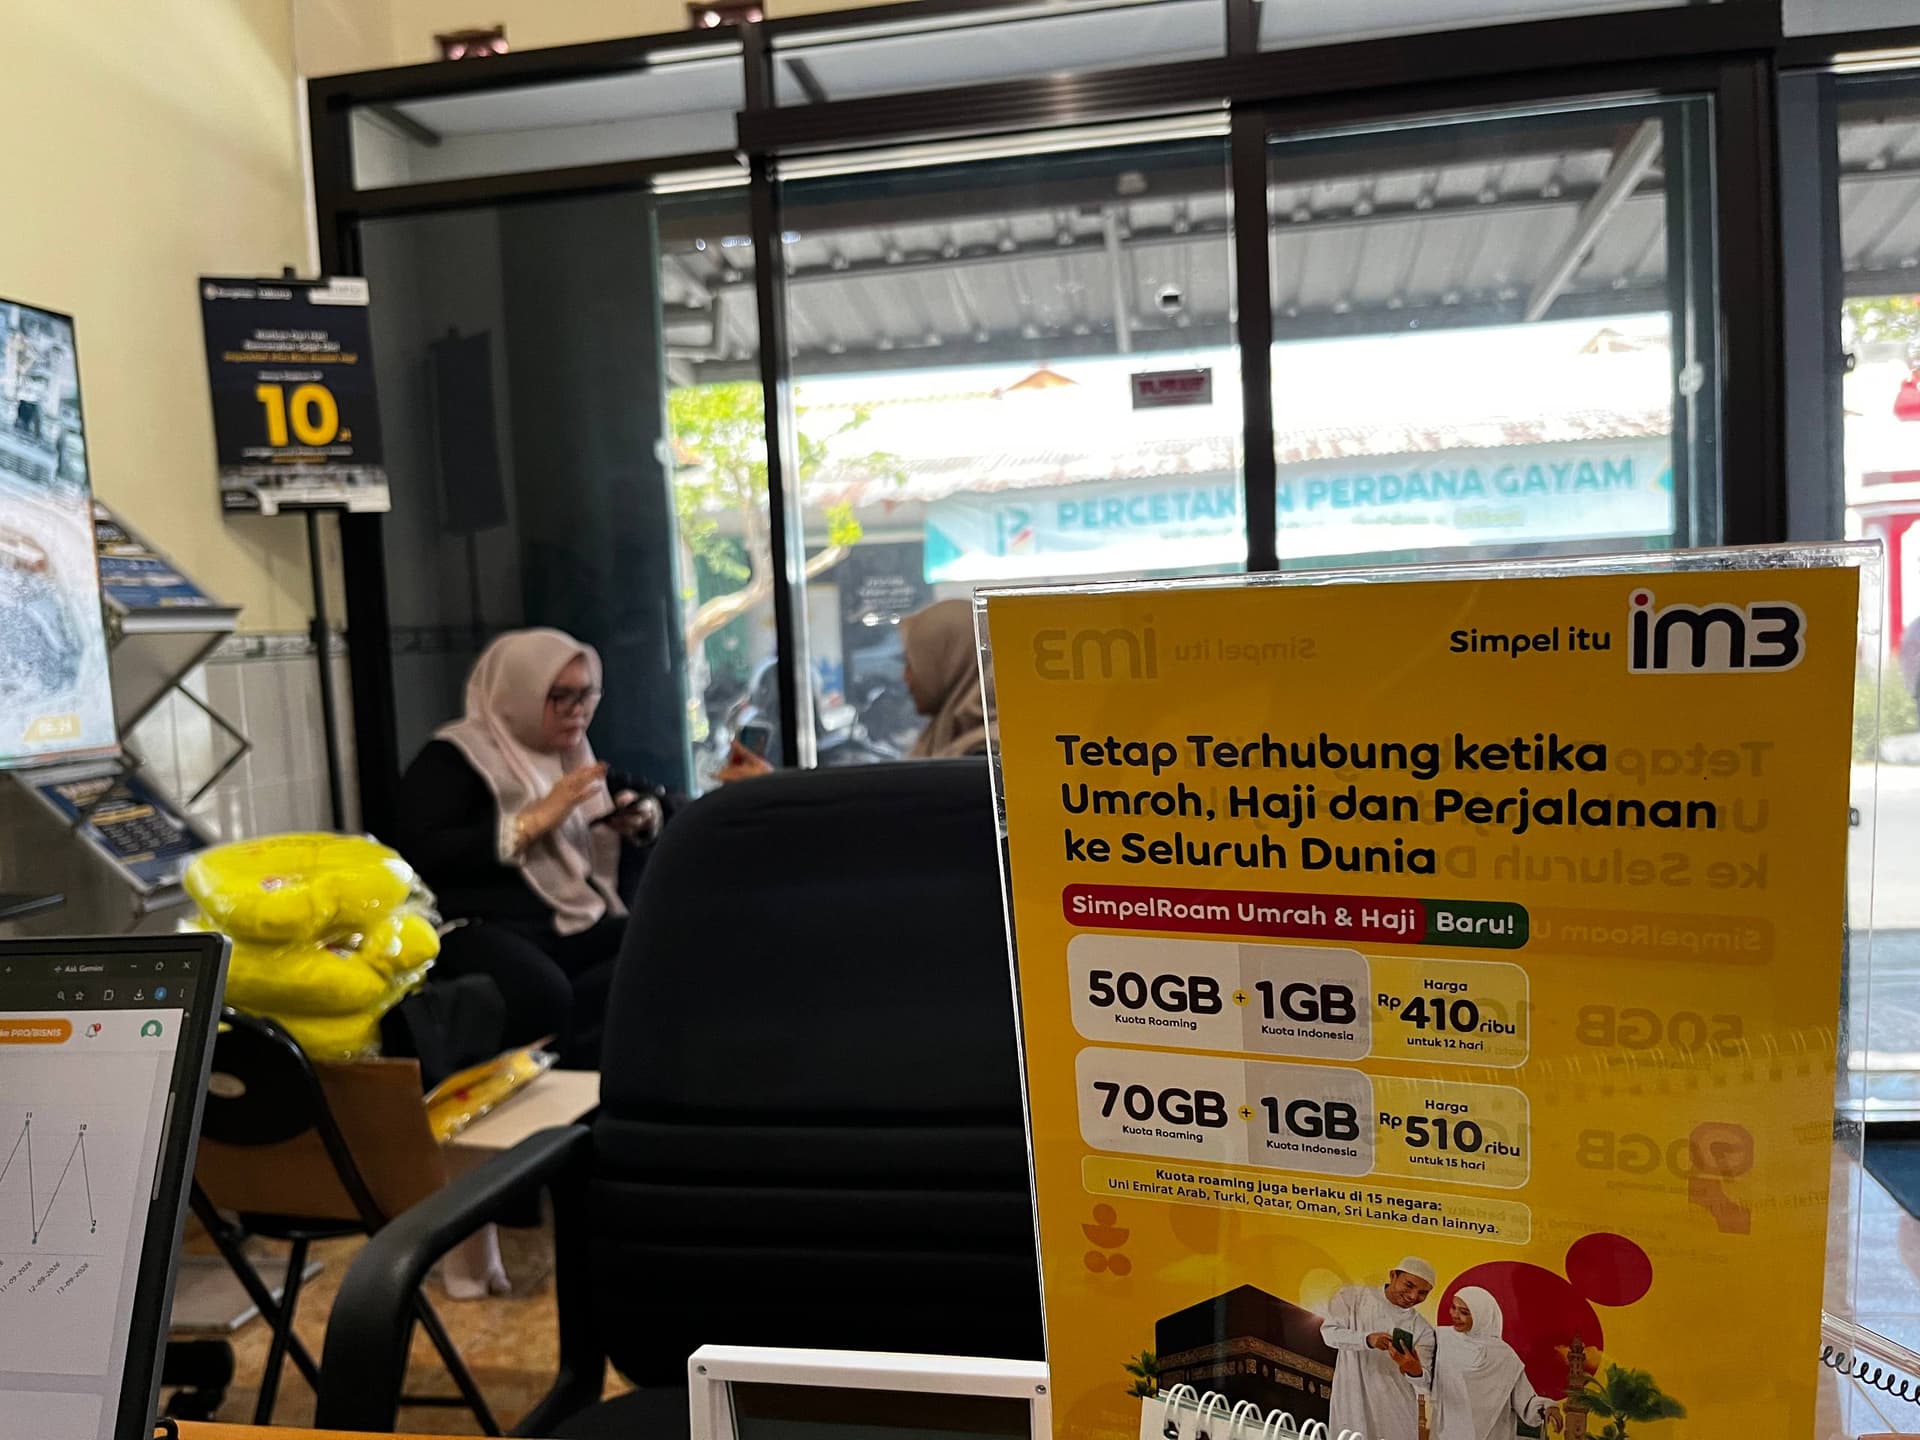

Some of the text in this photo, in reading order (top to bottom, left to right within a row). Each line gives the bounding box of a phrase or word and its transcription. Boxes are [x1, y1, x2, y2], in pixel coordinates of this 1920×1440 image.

[256, 383, 339, 447] 10
[1057, 456, 1634, 530] PERCETAKN PERDANA GAYAM
[1450, 593, 1800, 669] Simpel itu im3
[1055, 731, 1608, 780] Tetap Terhubung ketika
[1062, 782, 1216, 821] Umroh,
[1229, 784, 1316, 828] Haji
[1328, 785, 1420, 822] dan
[1434, 787, 1718, 835] Perjalanan
[1065, 828, 1111, 862] ke
[1121, 831, 1287, 869] Seluruh
[1301, 837, 1437, 873] Dunia
[1072, 894, 1231, 921] SimpelRoam
[1237, 902, 1328, 926] Umrah
[1334, 907, 1353, 927] &
[1361, 909, 1416, 935] Haji
[1437, 911, 1515, 936] Baru!
[1089, 969, 1223, 1015] 50GB
[1255, 980, 1357, 1025] 1GB
[1424, 979, 1468, 993] Harga
[1115, 1014, 1198, 1031] Kuota Roaming
[1261, 1025, 1354, 1041] Kuota Indonesia
[1378, 993, 1516, 1034] Rp 410 ribu
[1407, 1036, 1484, 1051] untuk 12 hari
[1093, 1081, 1228, 1129] 70GB
[1260, 1096, 1360, 1141] 1GB
[1425, 1099, 1469, 1114] Harga
[1122, 1125, 1203, 1143] Kuota Roaming
[1266, 1139, 1358, 1157] Kuota Indonesia
[1379, 1112, 1521, 1157] Rp 510 ribu
[1409, 1155, 1486, 1171] untuk 15 hari
[1108, 1178, 1500, 1235] Uni Emirat Arab, Turki, Qatar, Oman, Sri Lanka dan lainnya.
[1156, 1168, 1195, 1184] Kuota
[1198, 1175, 1255, 1192] roaming
[1257, 1180, 1288, 1196] juga
[1292, 1184, 1346, 1200] berlaku
[1350, 1191, 1362, 1202] di
[1367, 1193, 1382, 1205] 15
[1386, 1197, 1442, 1212] negara:
